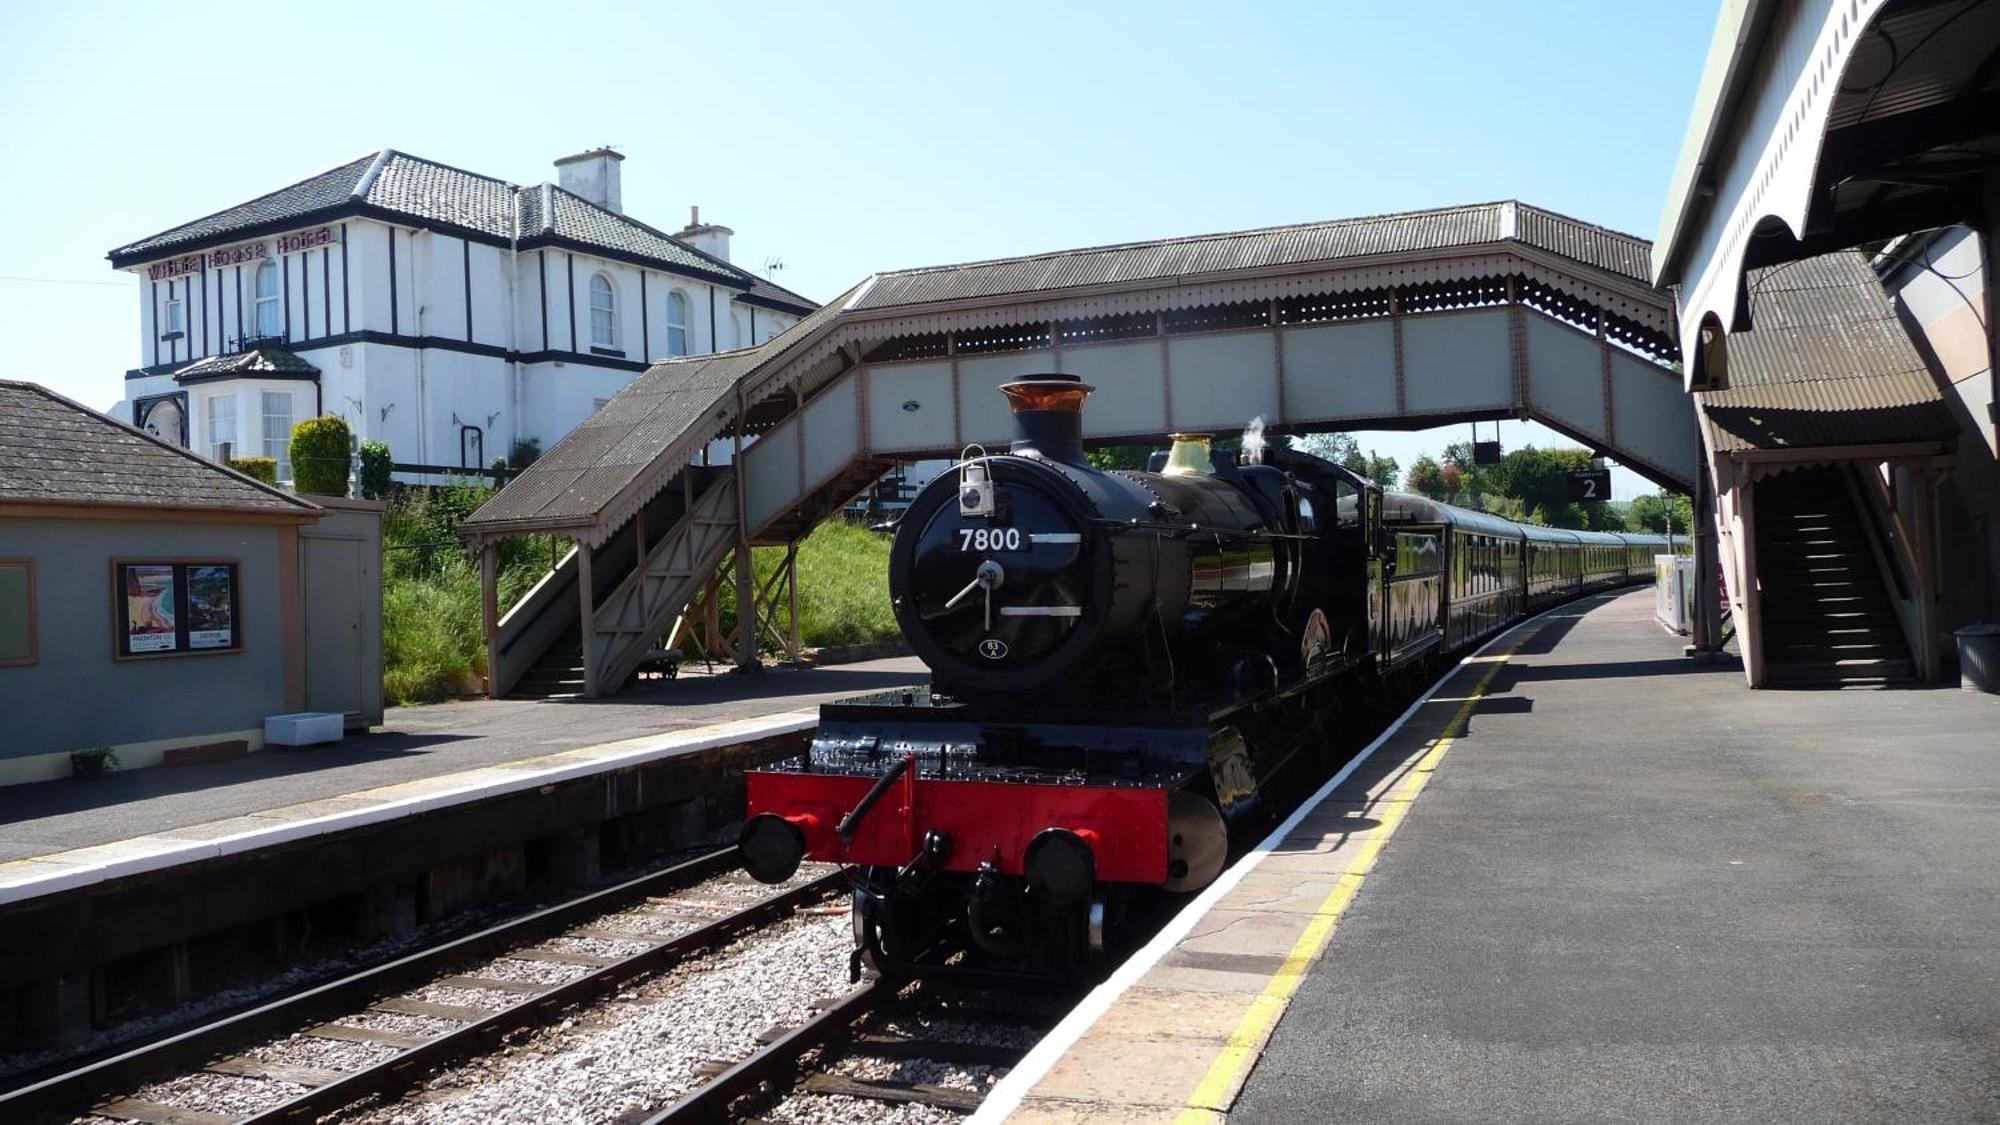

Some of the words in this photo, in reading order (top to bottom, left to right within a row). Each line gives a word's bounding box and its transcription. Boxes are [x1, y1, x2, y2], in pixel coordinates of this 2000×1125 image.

[277, 227, 336, 255] HOTEL
[1583, 479, 1597, 498] 2
[959, 528, 1020, 551] 7800
[987, 642, 998, 650] 83
[990, 649, 997, 657] A
